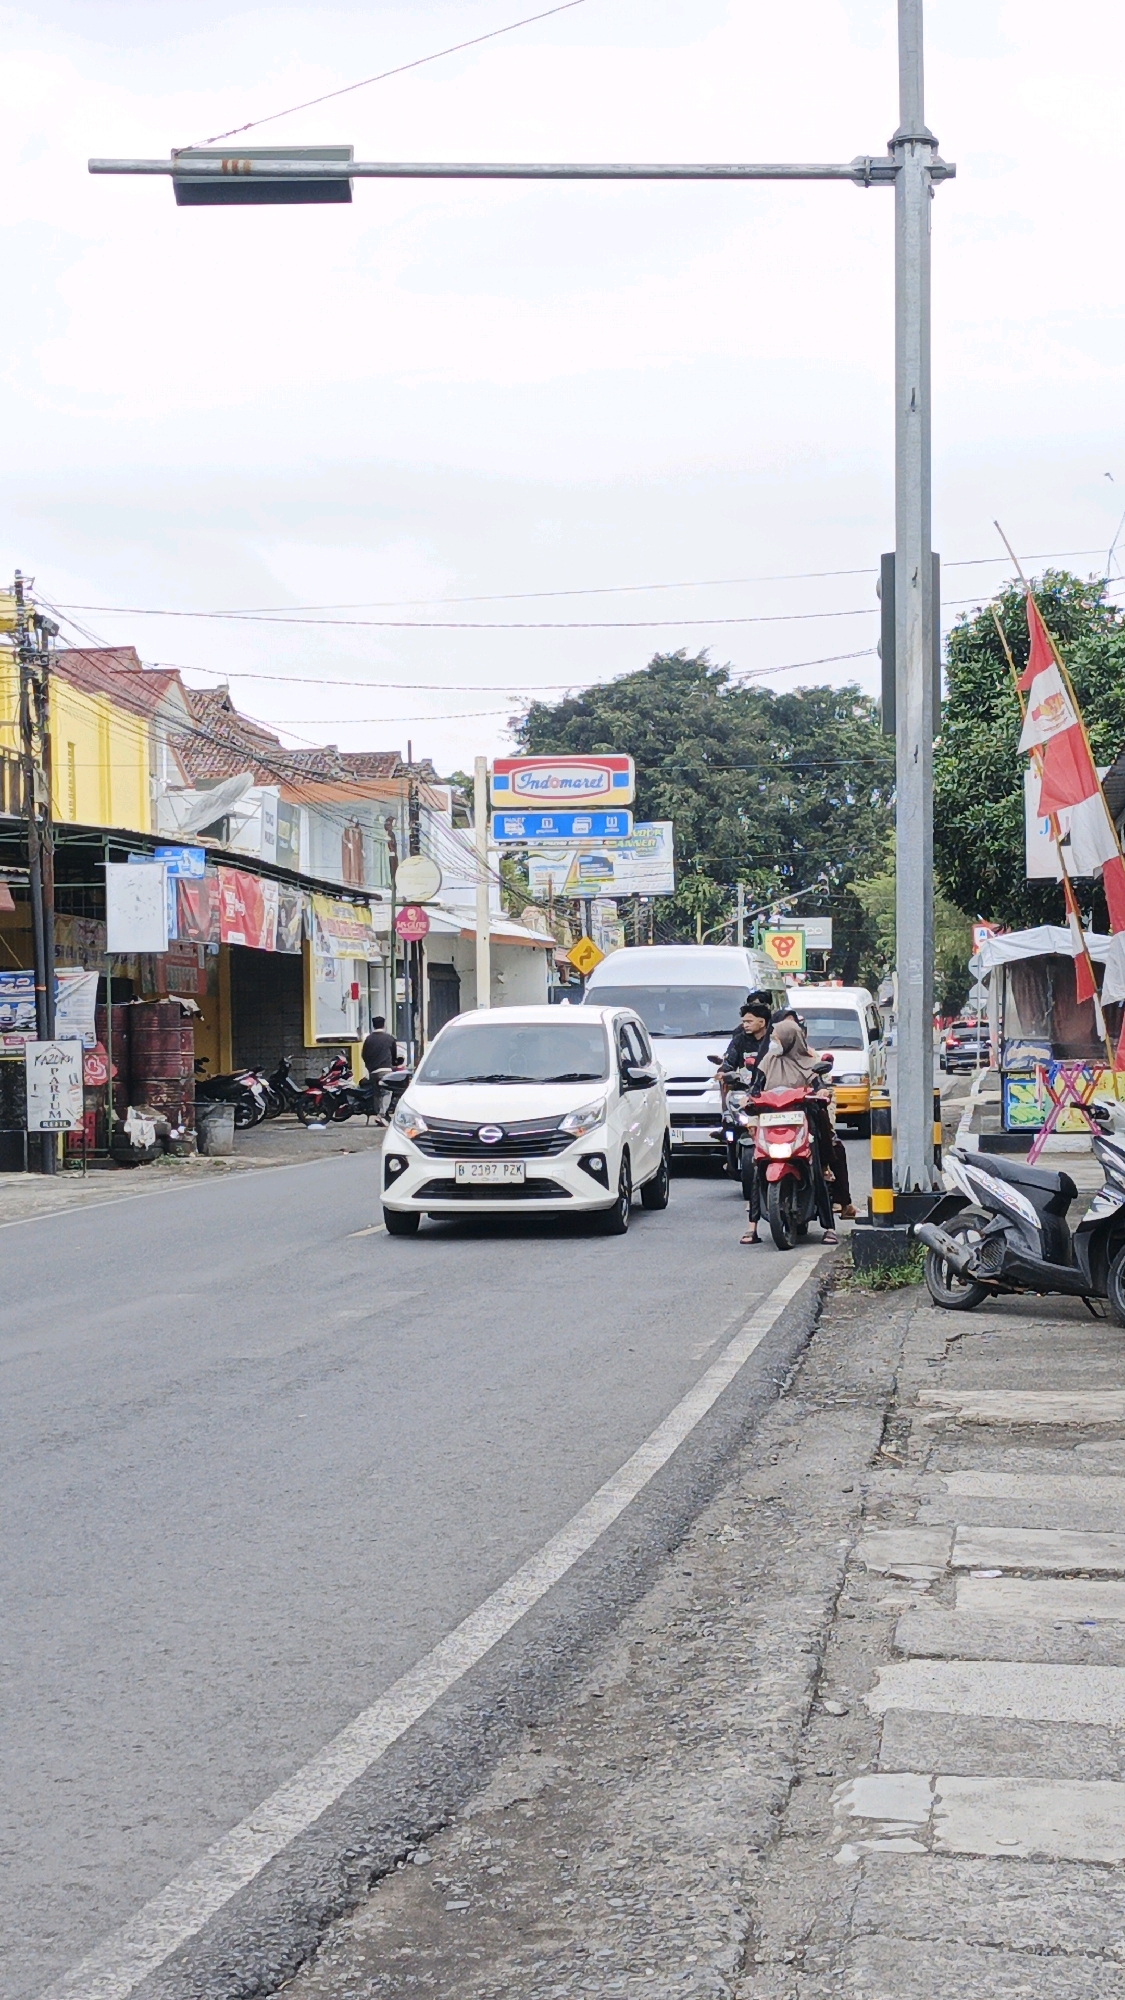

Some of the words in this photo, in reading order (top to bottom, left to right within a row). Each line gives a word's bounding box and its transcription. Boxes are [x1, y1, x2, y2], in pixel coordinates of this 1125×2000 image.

[517, 772, 604, 790] Indomaret
[458, 1164, 465, 1176] B
[503, 1164, 522, 1176] PZK
